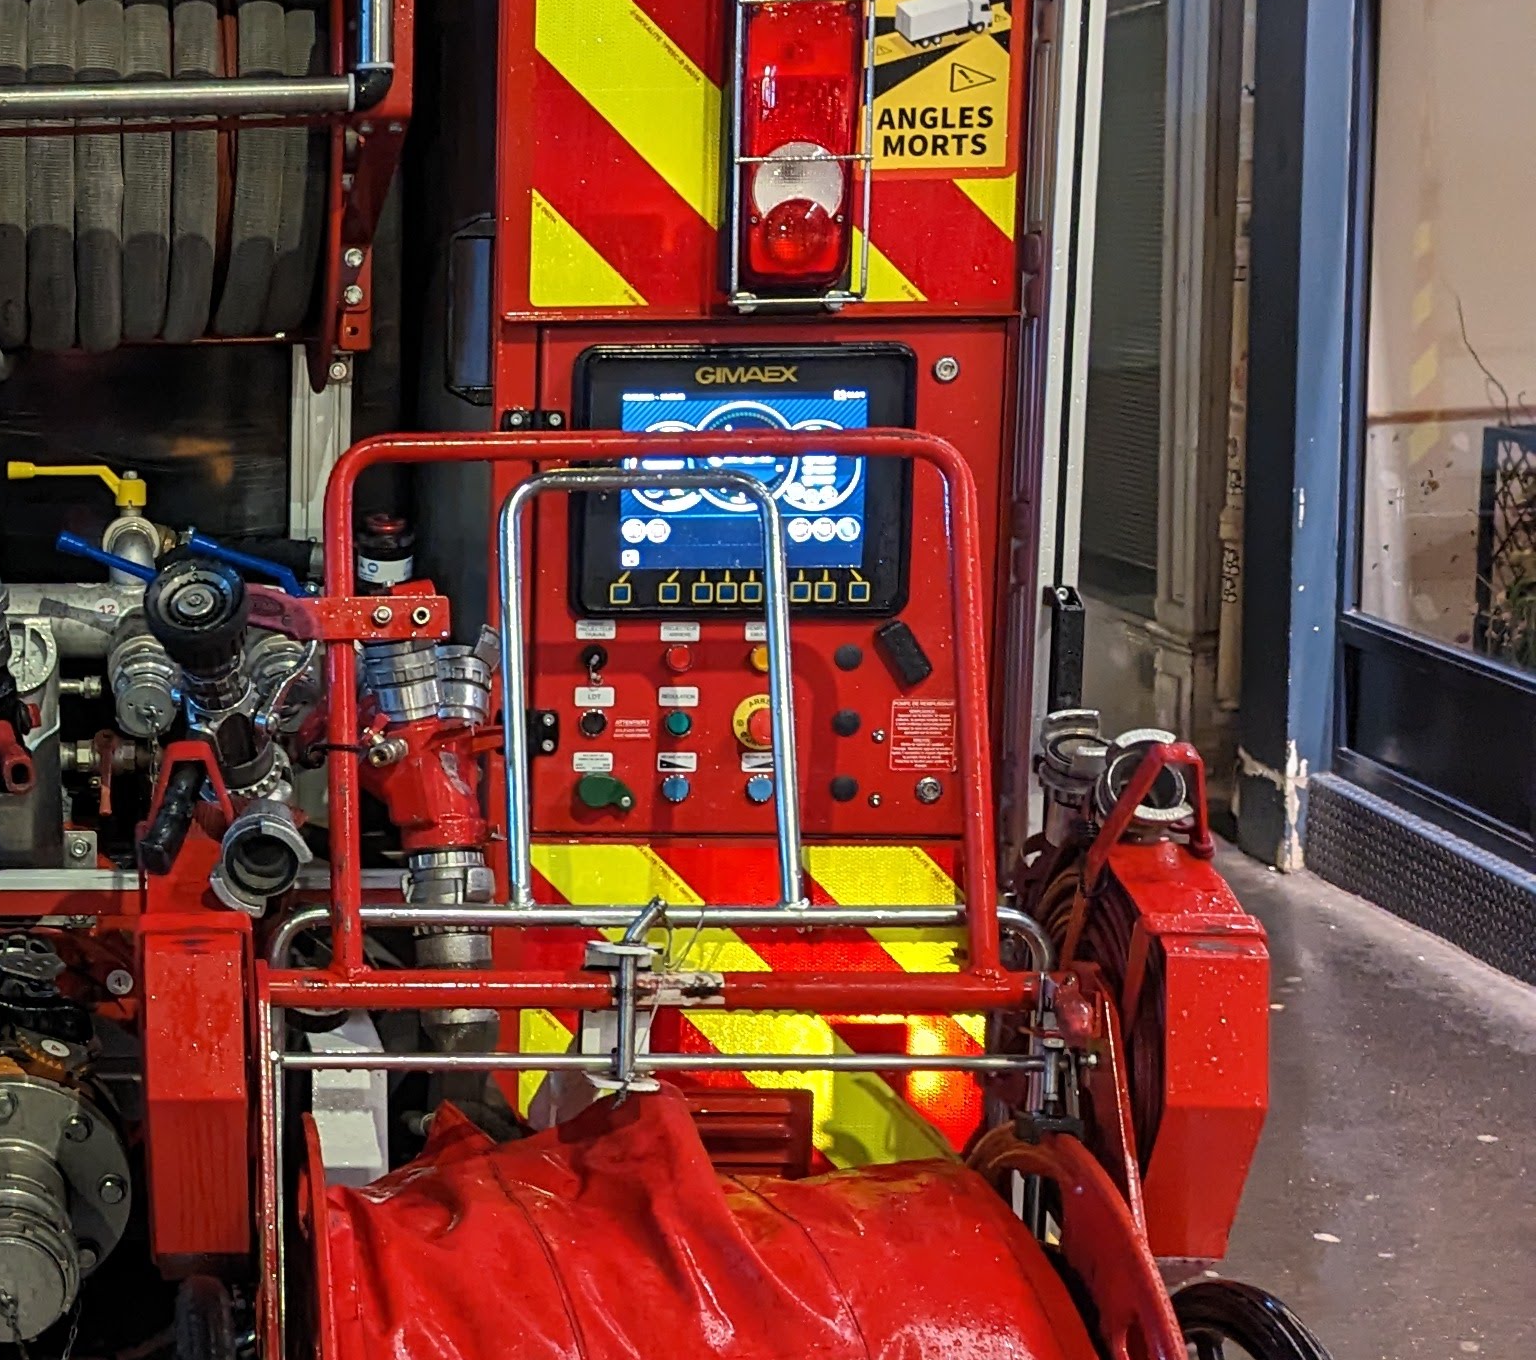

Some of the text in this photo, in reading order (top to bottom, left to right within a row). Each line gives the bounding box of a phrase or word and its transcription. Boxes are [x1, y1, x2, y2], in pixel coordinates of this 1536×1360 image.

[877, 106, 994, 131] ANGLES
[882, 134, 987, 157] MORTS
[695, 365, 798, 384] GIMAEX
[99, 604, 116, 615] 12
